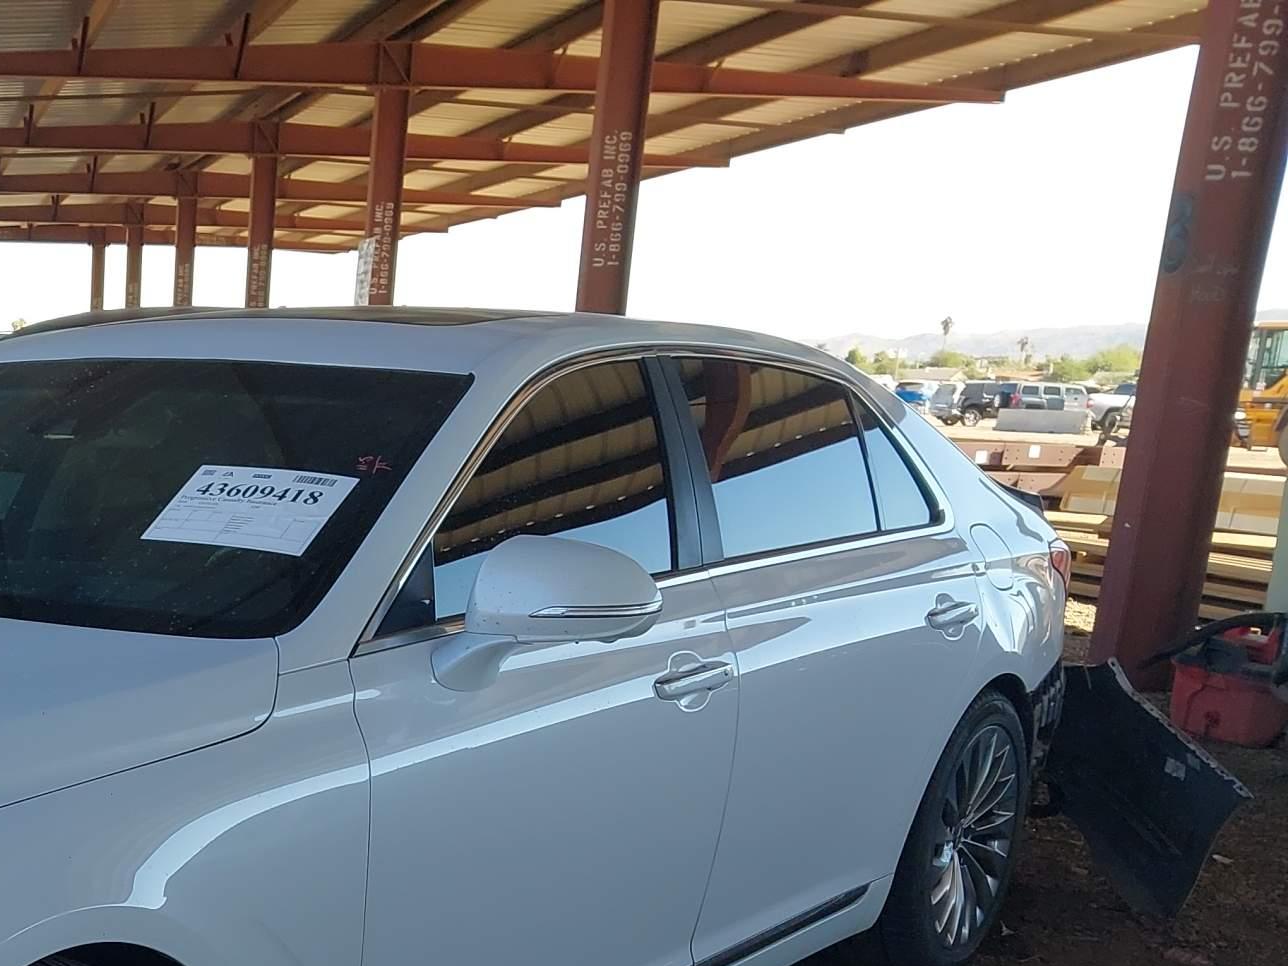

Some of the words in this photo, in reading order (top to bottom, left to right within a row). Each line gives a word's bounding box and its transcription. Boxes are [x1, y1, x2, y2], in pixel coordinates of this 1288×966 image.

[603, 129, 618, 160] INC.
[596, 168, 615, 229] PREFAB
[607, 131, 633, 266] 1-866-799-0969
[196, 481, 324, 506] 43609418
